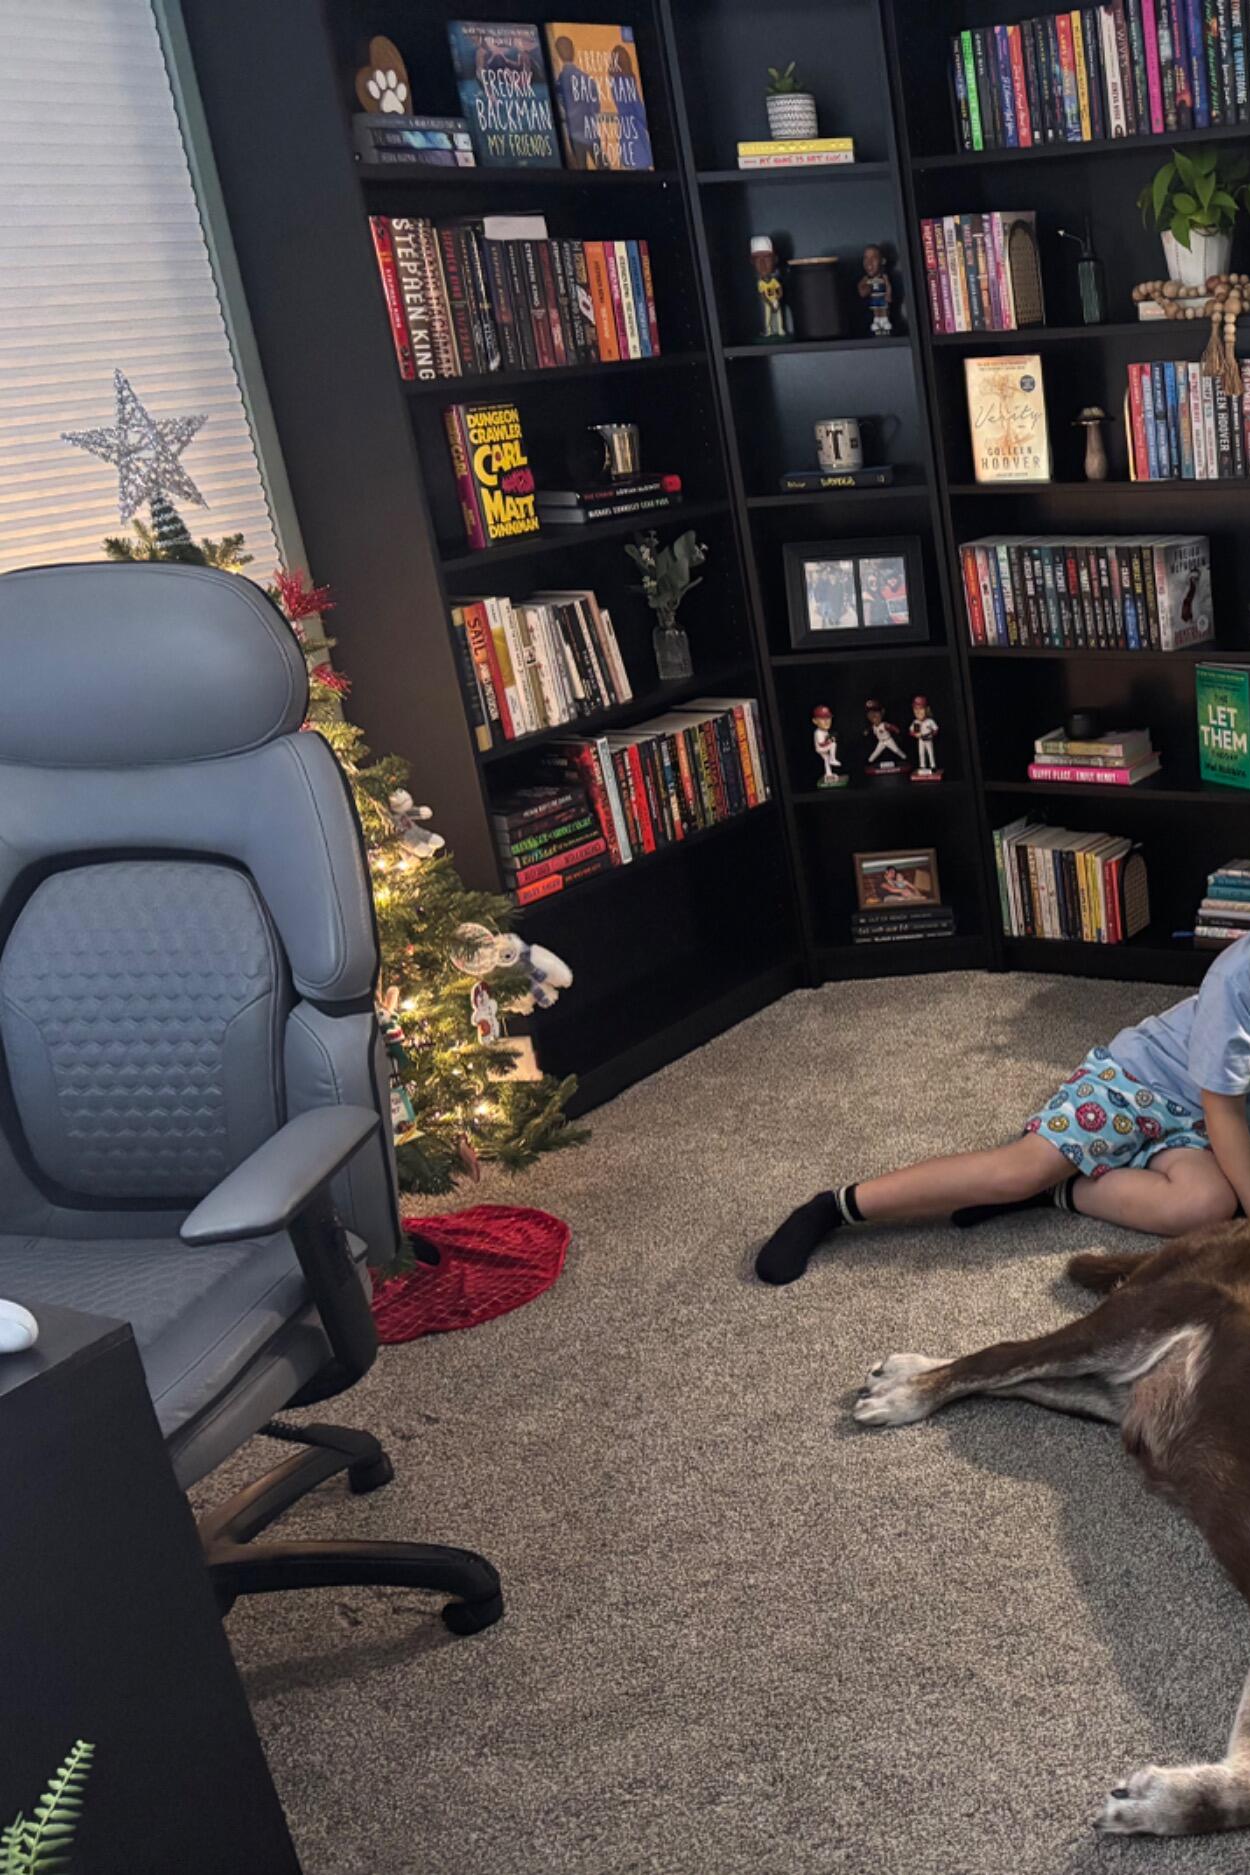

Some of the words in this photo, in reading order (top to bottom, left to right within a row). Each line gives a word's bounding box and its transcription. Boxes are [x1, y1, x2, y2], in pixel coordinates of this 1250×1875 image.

[1117, 28, 1126, 67] WIVES
[480, 69, 536, 98] FREDRIK
[476, 98, 552, 132] BACKMAN
[487, 136, 506, 156] MY
[508, 135, 552, 157] FRIENDS
[593, 141, 637, 167] PEOPLE
[525, 242, 535, 283] STEPHEN
[531, 284, 540, 307] KING
[392, 218, 423, 321] STEPHEN
[411, 329, 436, 381] KING
[466, 409, 519, 428] DUNGEON
[975, 402, 1042, 430] Verity
[469, 424, 523, 446] CRAWLER
[826, 430, 843, 460] T
[1217, 412, 1230, 451] HOOVER
[473, 440, 528, 487] CARL
[981, 456, 1041, 471] HOOVER
[987, 446, 1033, 456] COLLEEN
[480, 487, 536, 526] MATT
[488, 517, 541, 539] DINNIMAN
[467, 617, 484, 656] SAIL
[1207, 704, 1238, 728] LET
[1201, 726, 1248, 753] THEM
[1032, 769, 1052, 780] HAPPY
[1053, 770, 1071, 780] PLACE
